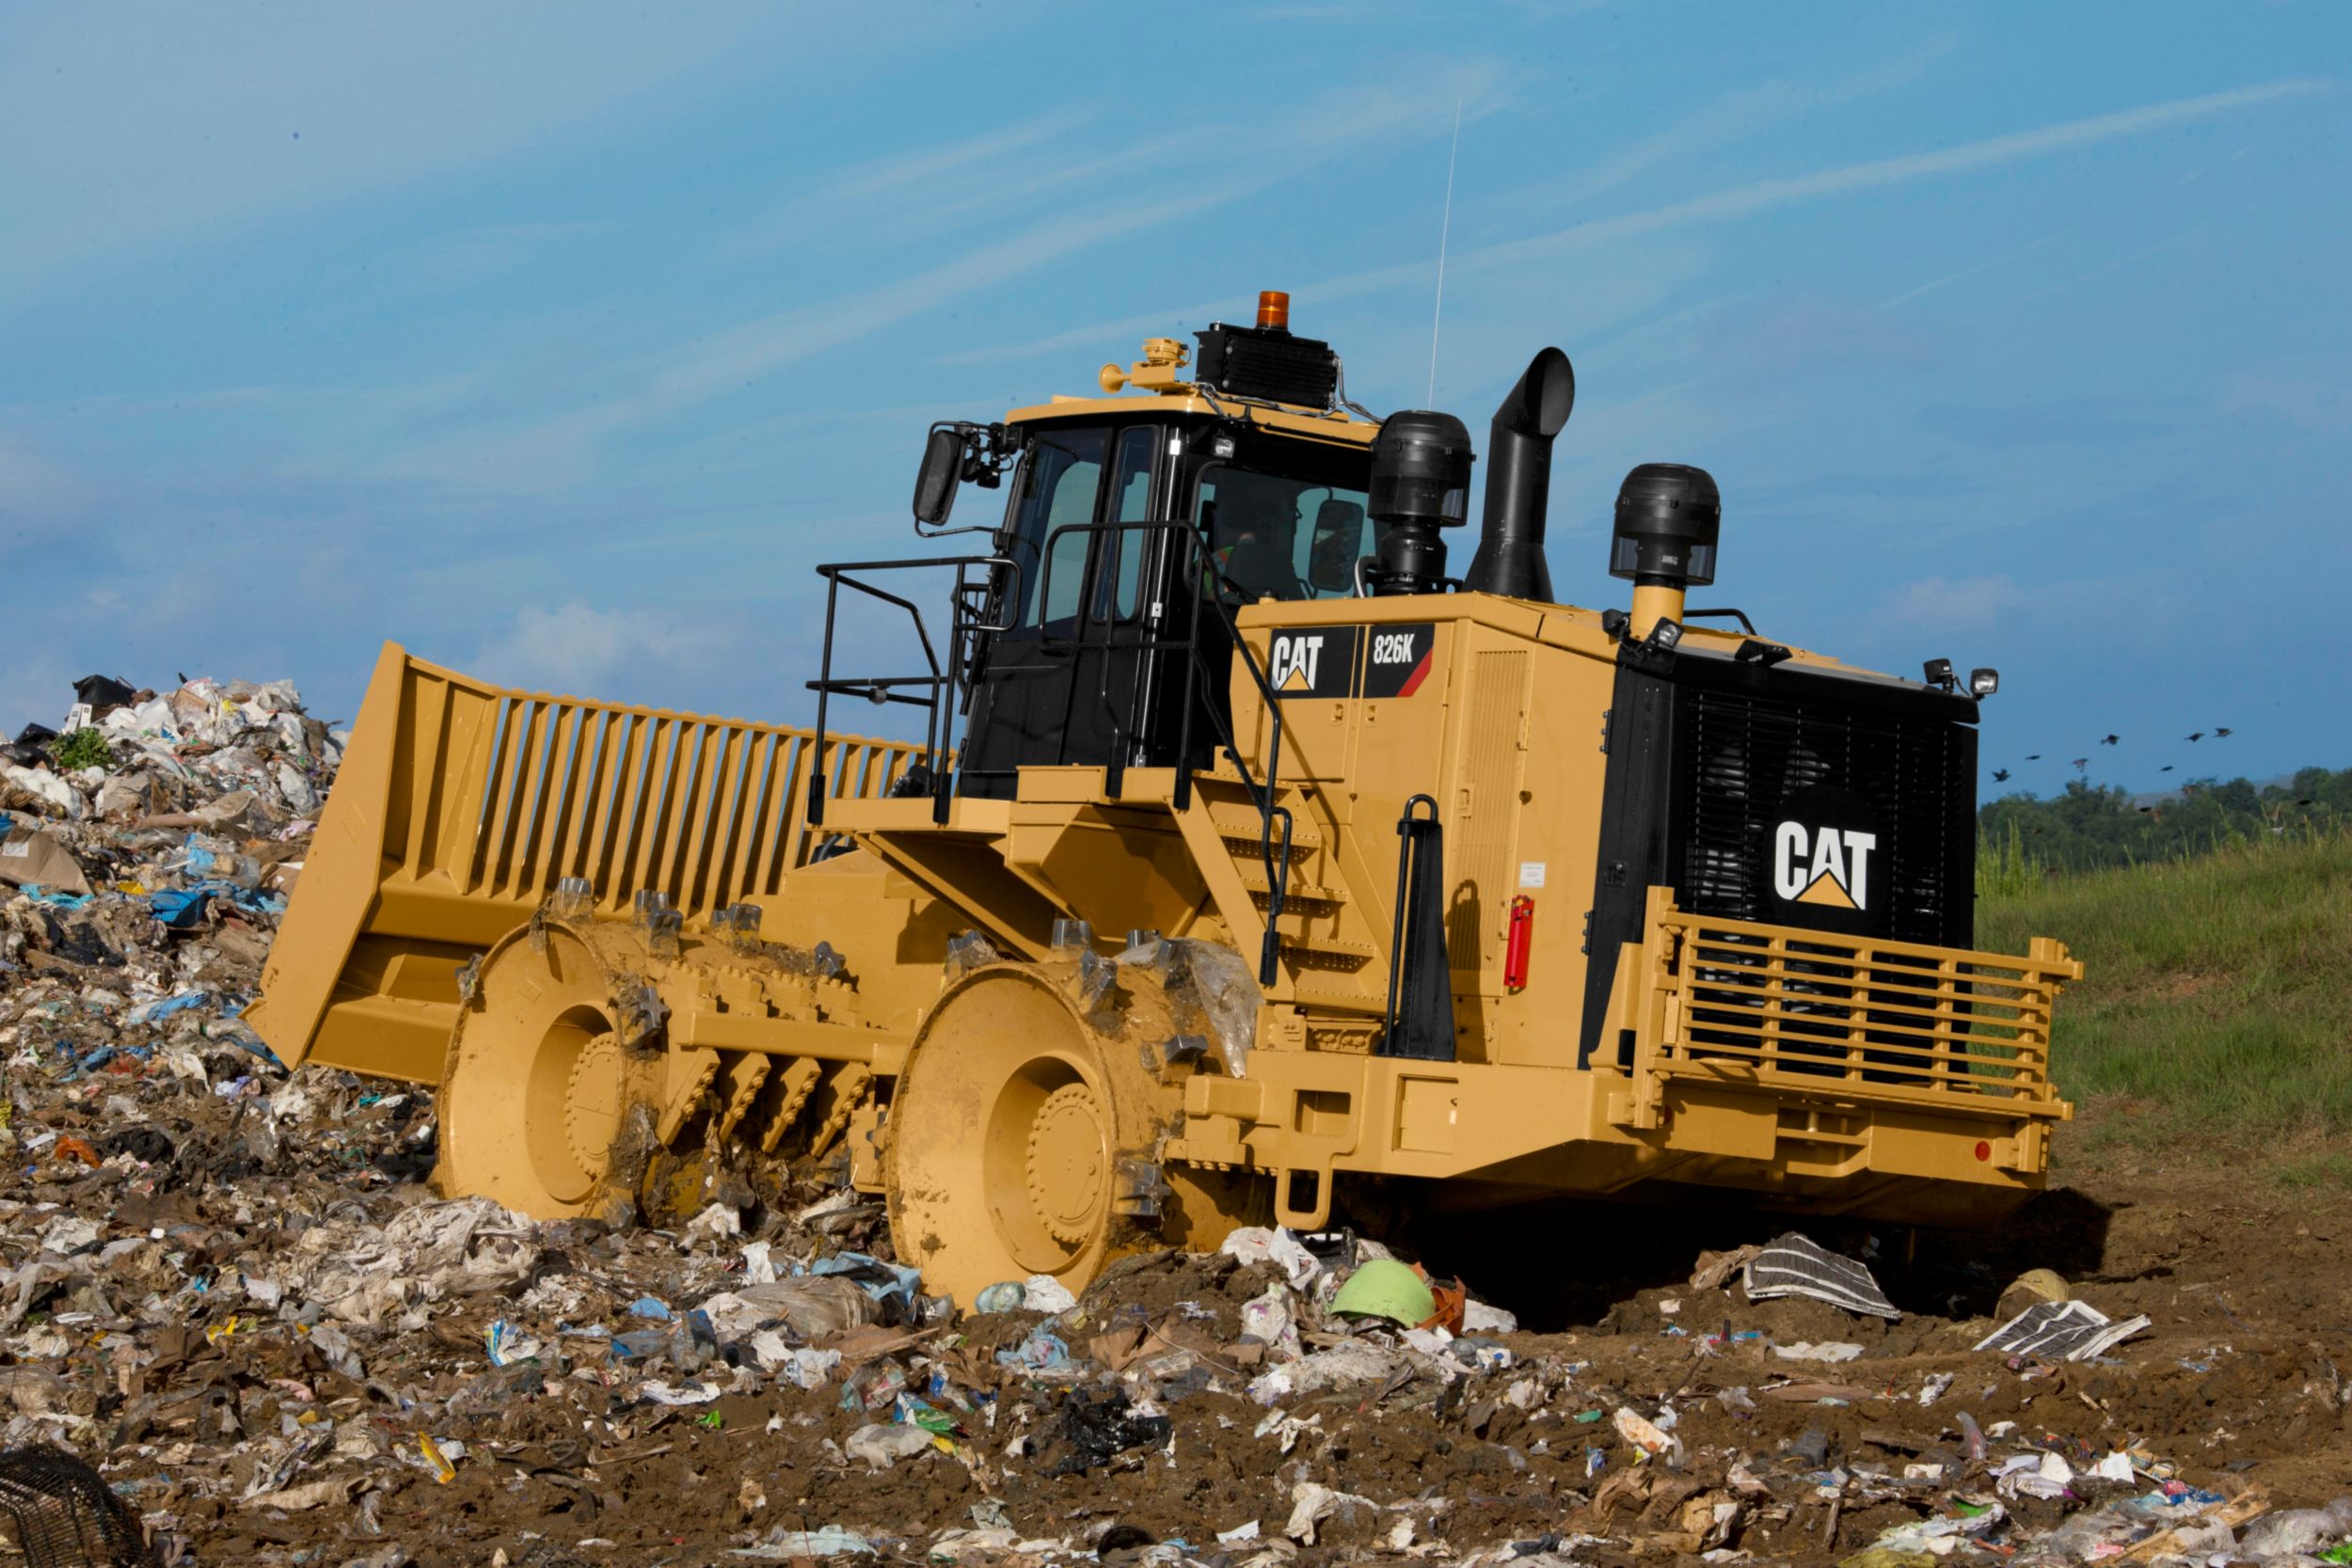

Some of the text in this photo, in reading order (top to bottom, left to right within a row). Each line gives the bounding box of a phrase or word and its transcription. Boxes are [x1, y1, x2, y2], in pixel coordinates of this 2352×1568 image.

[1271, 636, 1324, 690] CAT
[1373, 633, 1415, 664] 826K
[1774, 820, 1876, 911] CAT
